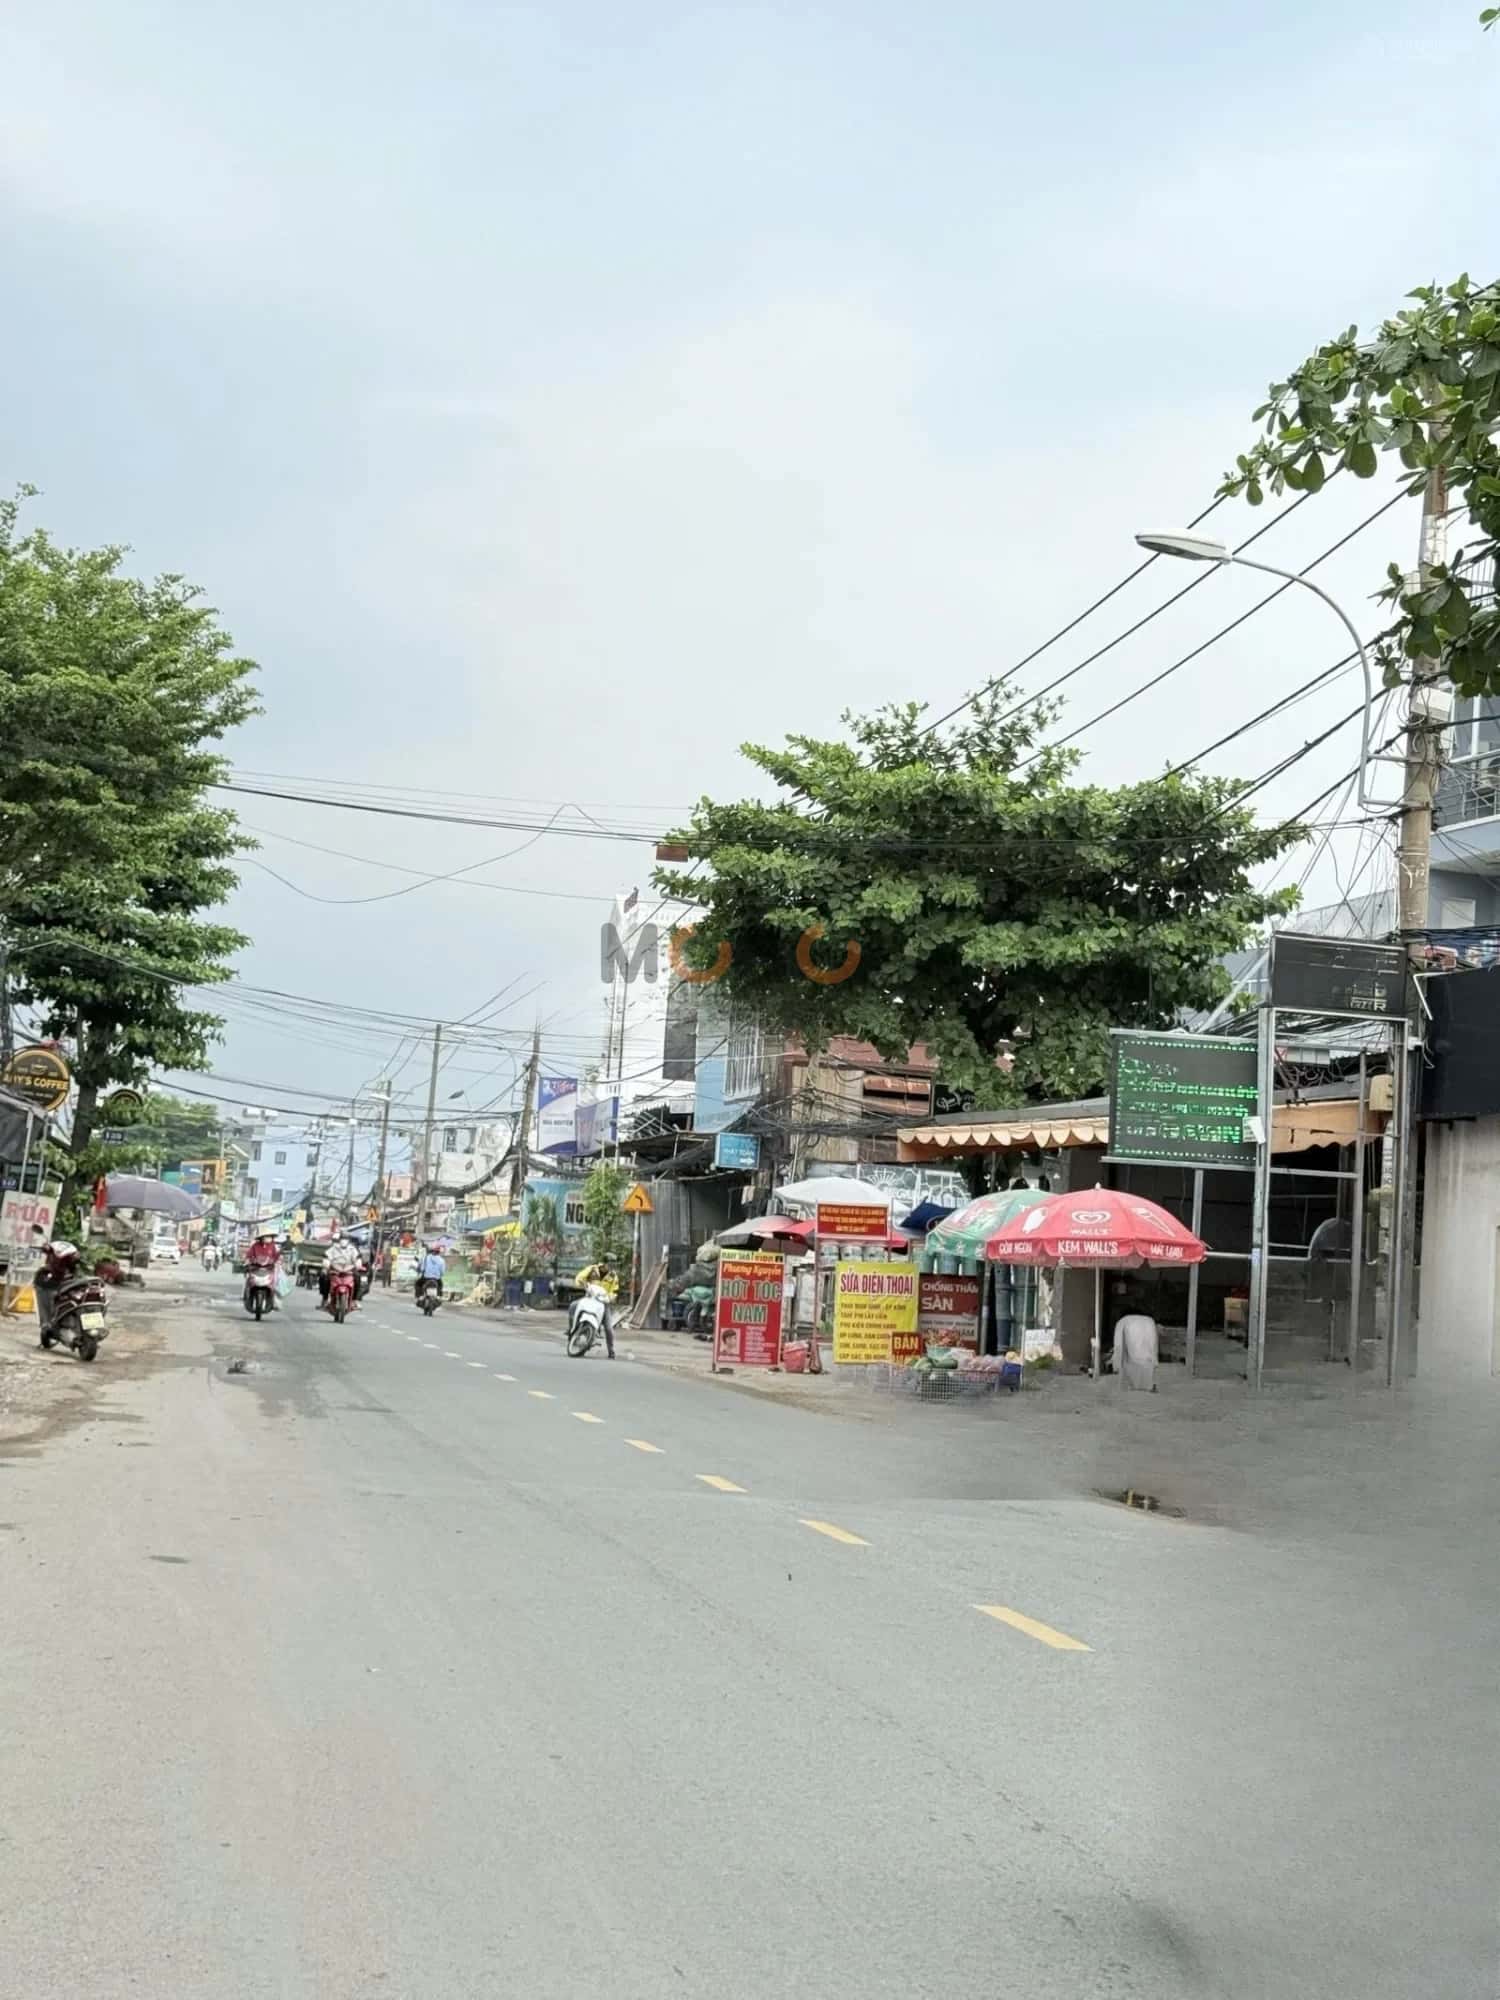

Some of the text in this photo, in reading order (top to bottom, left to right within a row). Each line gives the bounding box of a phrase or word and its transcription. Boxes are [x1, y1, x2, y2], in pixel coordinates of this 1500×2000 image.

[34, 1077, 69, 1091] COFFEE
[1058, 1240, 1118, 1255] KEM WALL'S
[732, 1303, 768, 1324] NAM
[893, 1334, 919, 1350] BÁN
